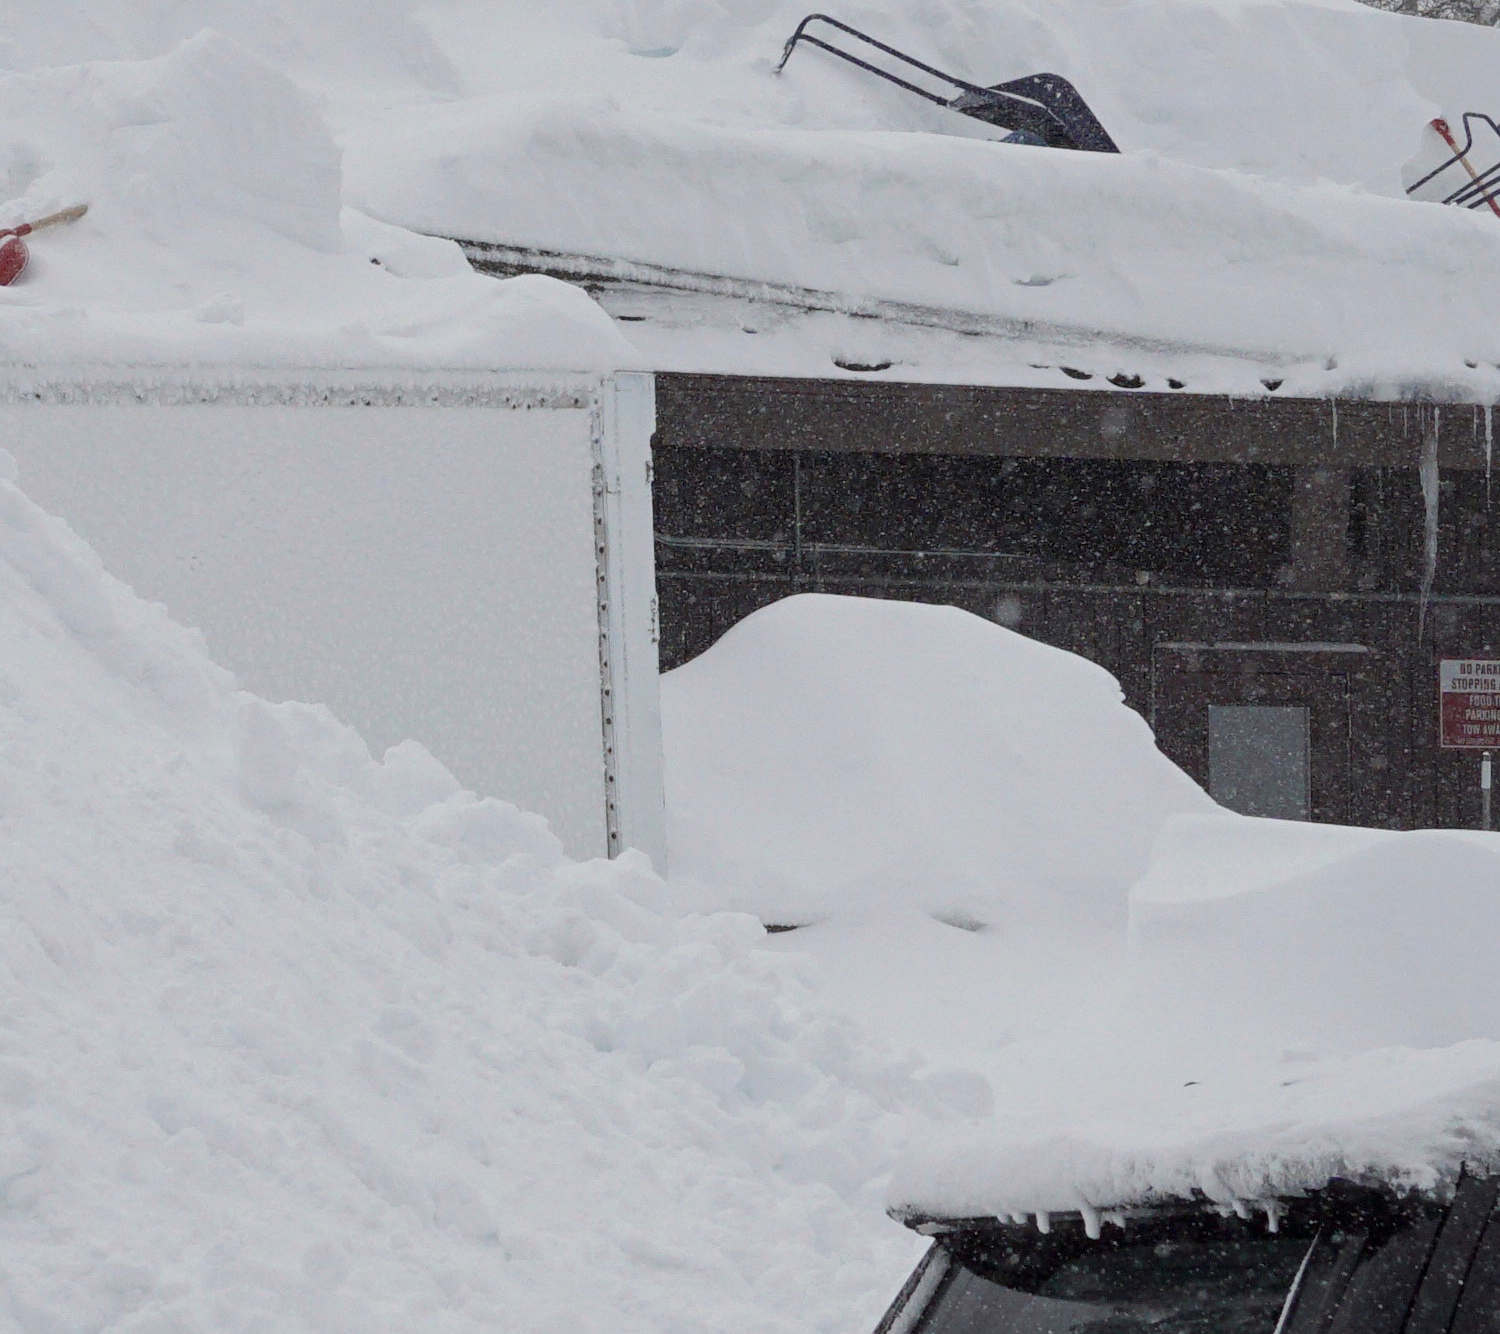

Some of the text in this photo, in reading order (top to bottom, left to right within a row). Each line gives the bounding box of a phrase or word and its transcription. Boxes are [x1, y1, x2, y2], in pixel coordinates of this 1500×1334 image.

[1459, 662, 1472, 675] NO
[1451, 678, 1496, 690] STOPPING
[1469, 695, 1492, 707] FOOD
[1462, 724, 1480, 735] TOW
